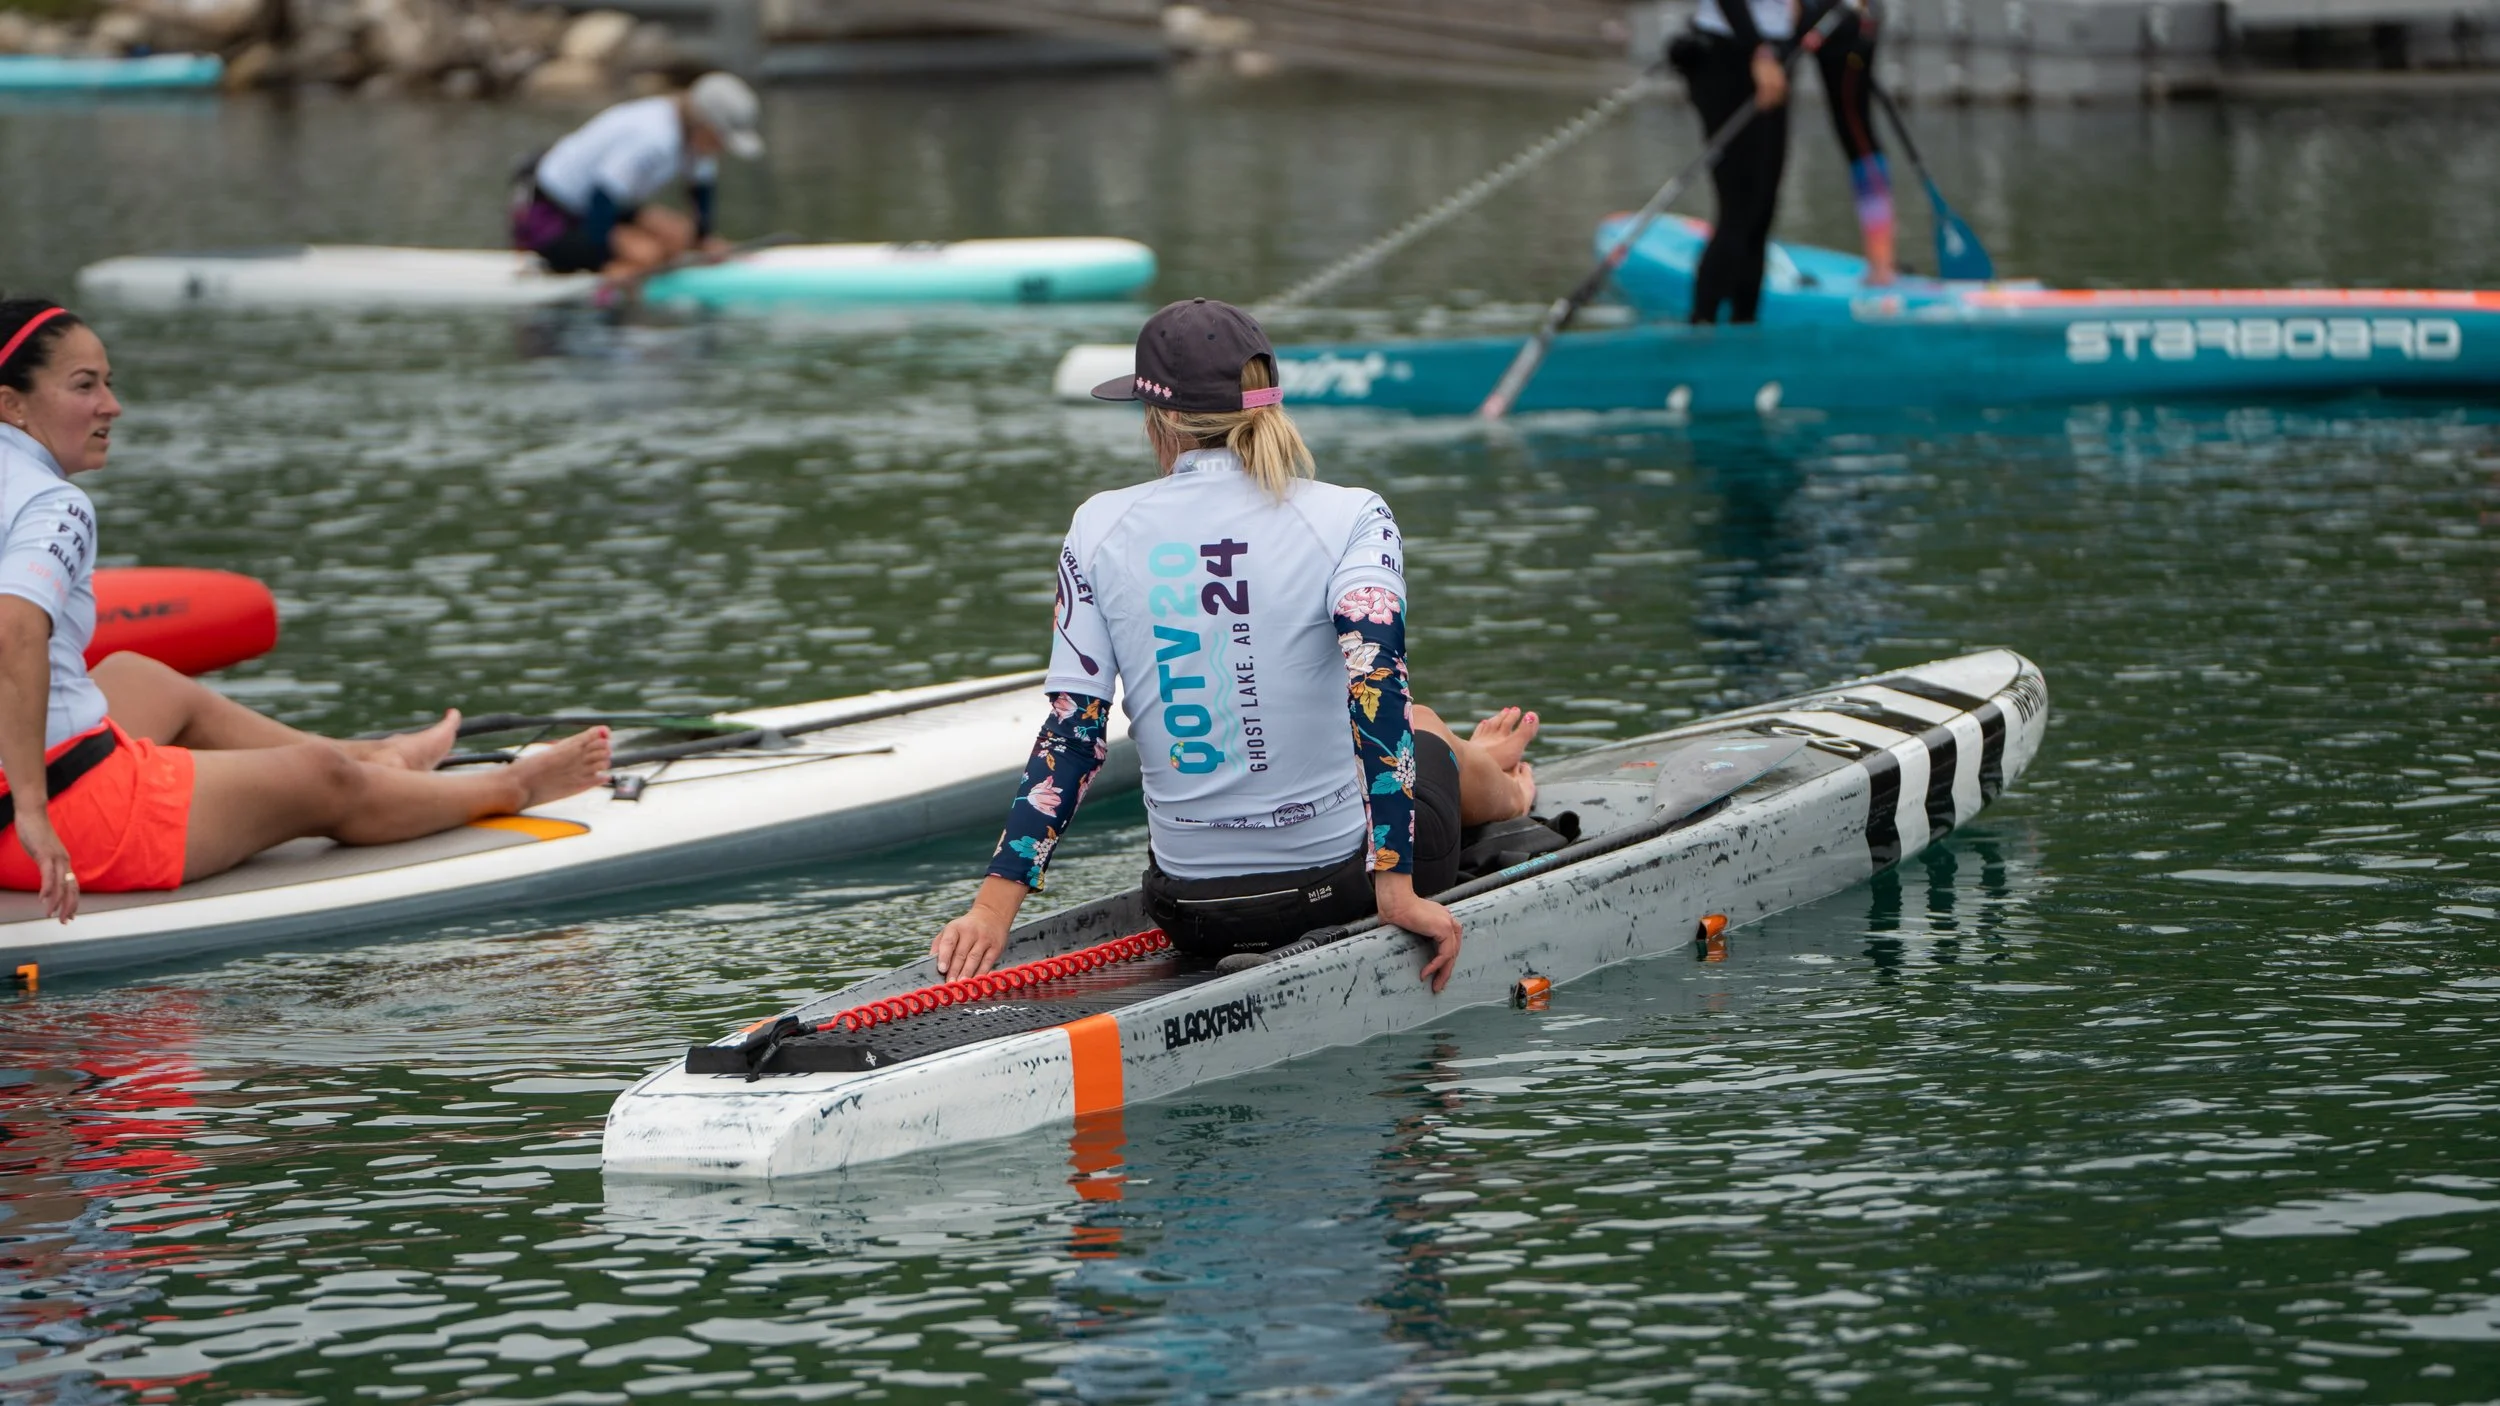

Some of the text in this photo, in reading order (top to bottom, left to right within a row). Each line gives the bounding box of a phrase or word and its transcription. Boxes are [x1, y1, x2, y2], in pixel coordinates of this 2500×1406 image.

[1200, 538, 1250, 616] 24
[1233, 623, 1269, 773] GHOST LAKE, AB
[1164, 993, 1253, 1050] BLACKFISH
